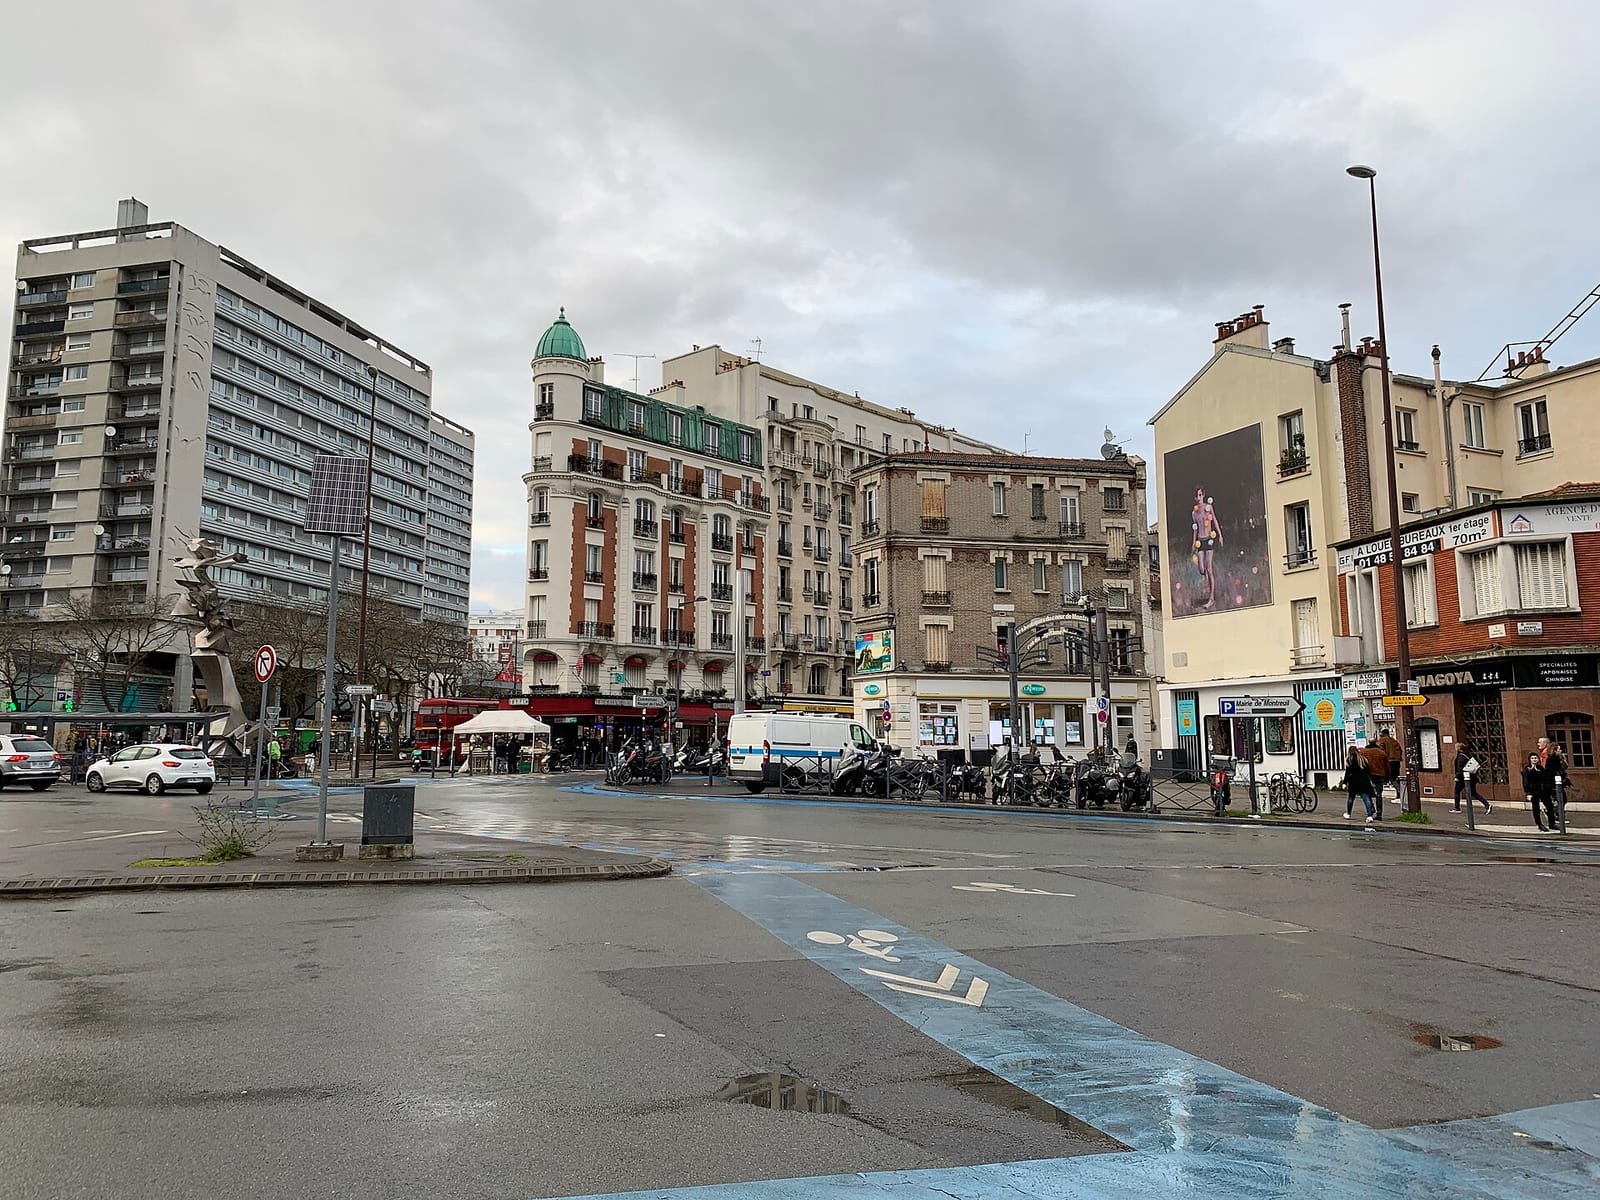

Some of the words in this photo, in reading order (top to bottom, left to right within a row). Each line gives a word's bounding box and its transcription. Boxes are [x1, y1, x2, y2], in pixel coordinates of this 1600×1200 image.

[1545, 505, 1587, 516] AGENCE
[1450, 523, 1461, 533] 1er
[1464, 516, 1489, 529] étage
[1357, 547, 1363, 556] A
[1366, 538, 1393, 555] LOUE
[1400, 525, 1446, 546] BUREAUX
[1374, 554, 1387, 565] 48
[1404, 546, 1418, 558] 84
[1420, 542, 1435, 554] 84
[1415, 671, 1475, 688] NAGOYA
[1254, 699, 1262, 707] de
[1263, 699, 1290, 707] Montreuil
